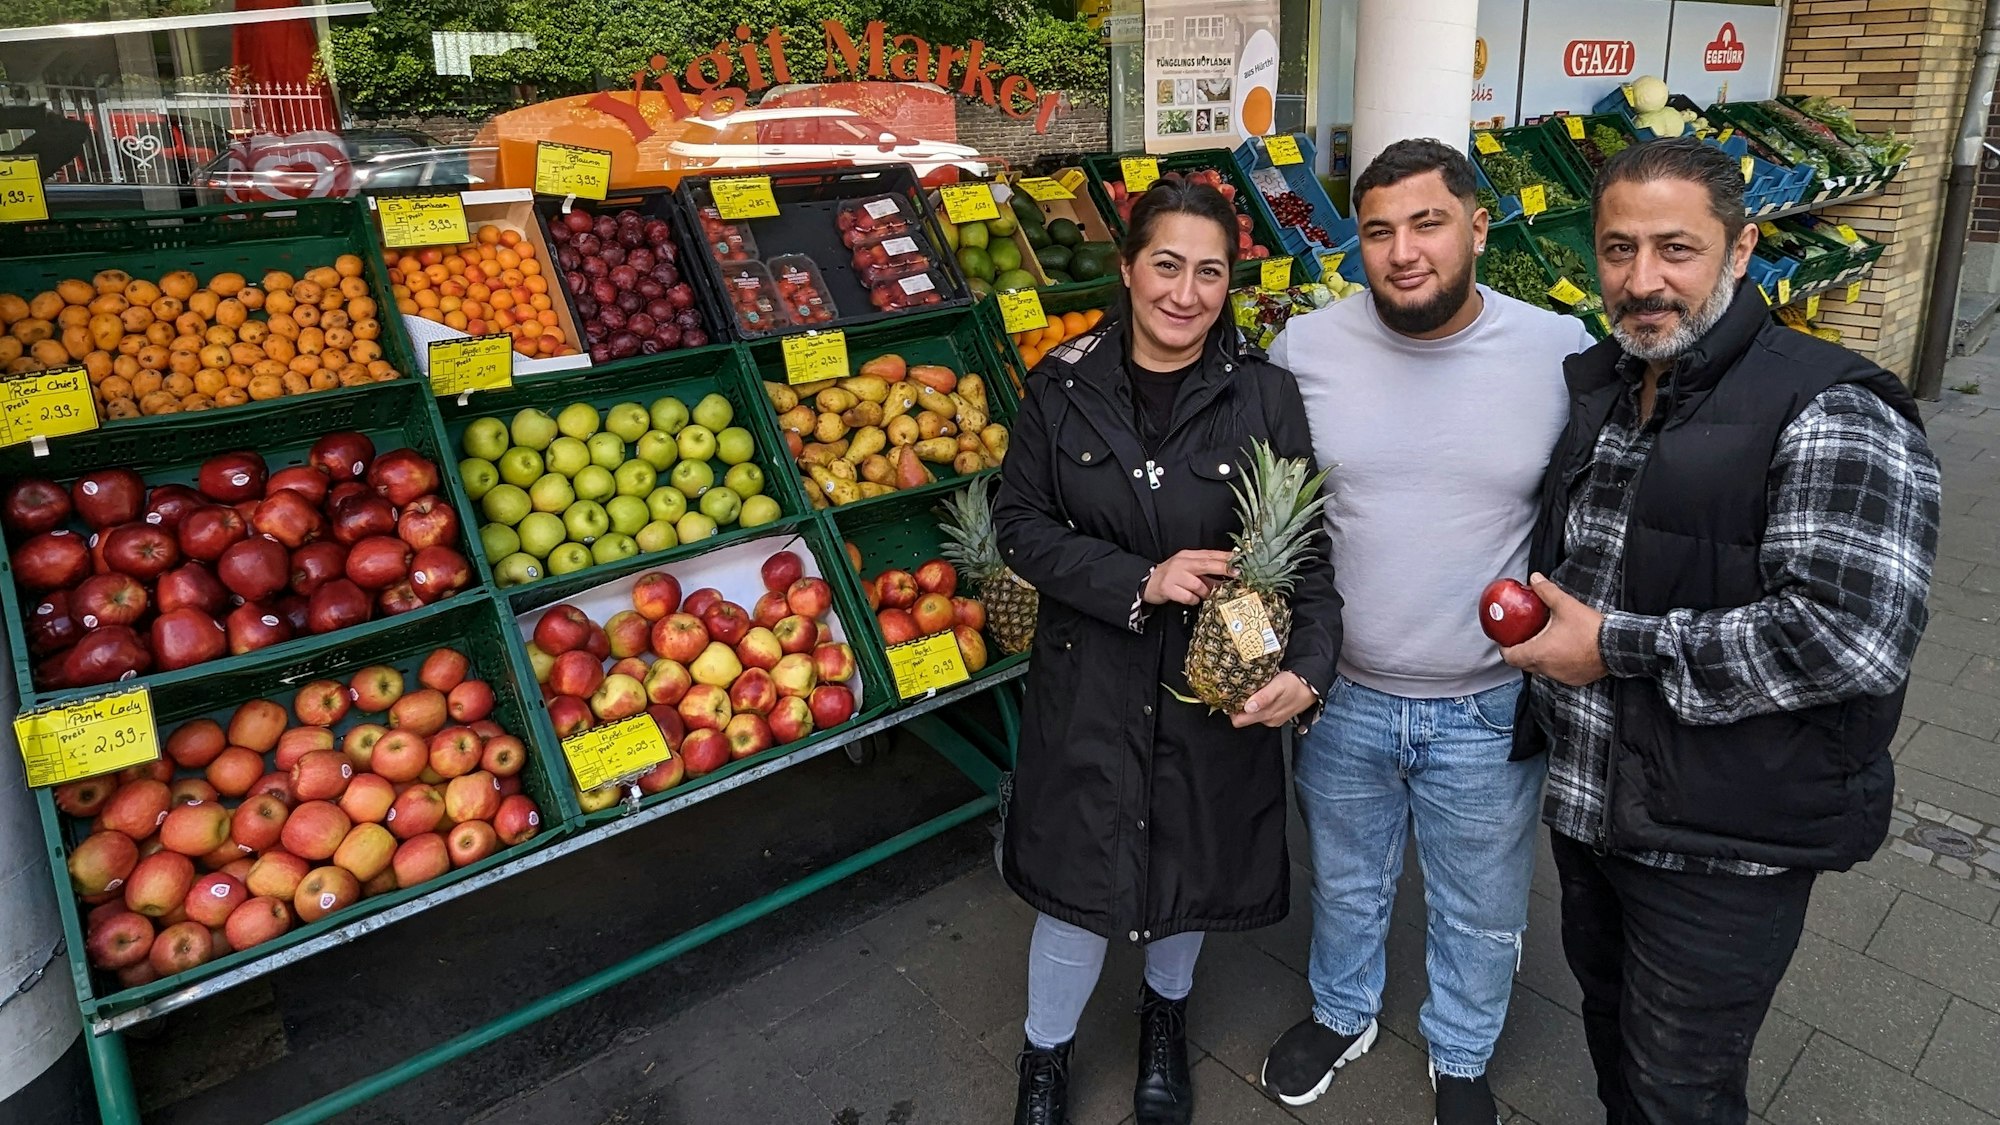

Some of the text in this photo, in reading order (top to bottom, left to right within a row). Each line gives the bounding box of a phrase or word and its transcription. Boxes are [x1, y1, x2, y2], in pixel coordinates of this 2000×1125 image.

[1706, 46, 1743, 64] EGETÜRK
[586, 25, 790, 143] Yigit
[10, 382, 42, 399] Red
[6, 399, 29, 412] Preis
[68, 700, 142, 726] Pink Lady
[60, 727, 86, 743] Preis
[598, 741, 615, 754] Preis
